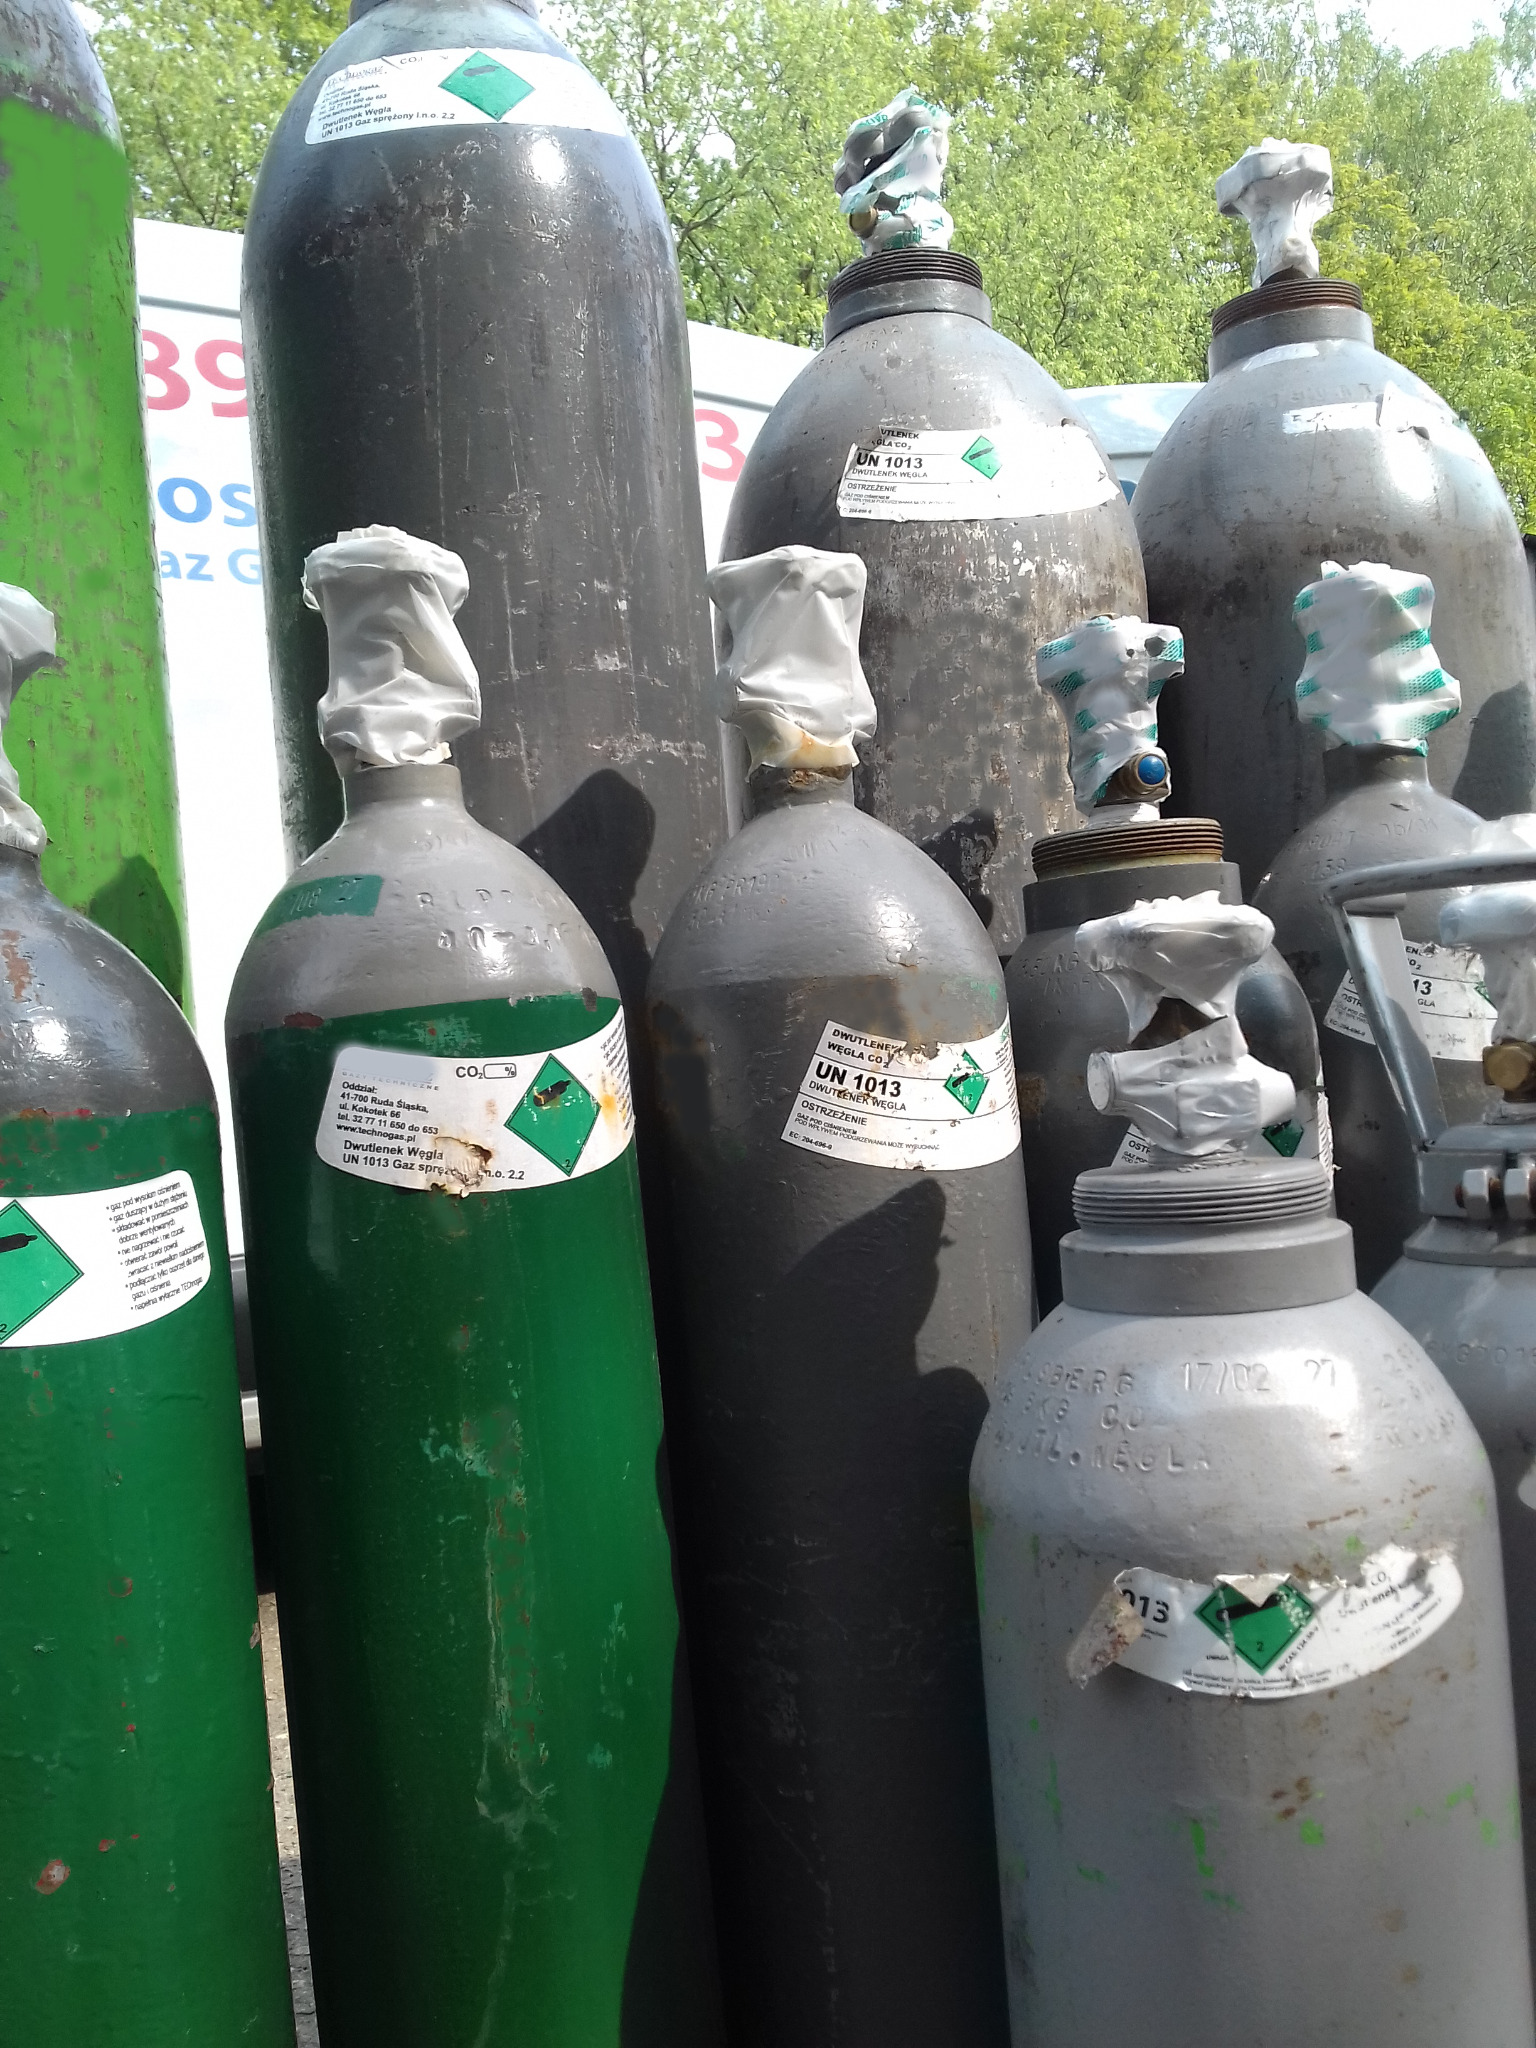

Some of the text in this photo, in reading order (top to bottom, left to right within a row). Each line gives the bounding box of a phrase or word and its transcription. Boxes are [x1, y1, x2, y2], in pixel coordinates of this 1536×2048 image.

[322, 106, 392, 130] Dwutlenek Węgla
[322, 128, 332, 138] UN
[335, 122, 353, 132] 1013
[355, 118, 372, 126] Gaz
[374, 112, 414, 123] sprężony
[442, 112, 456, 120] 2.2
[695, 409, 746, 482] 3
[856, 452, 923, 468] UN 1013
[852, 468, 898, 478] DWUTLENEK
[847, 482, 897, 492] OSTRZEŻENIE
[828, 1041, 864, 1060] WĘGLA
[342, 1081, 378, 1094] Oddział:
[816, 1060, 901, 1098] UN 1013
[340, 1092, 430, 1114] 41-700 Ruda Śląska,
[808, 1080, 906, 1111] DWUTLENEK WĘGLA
[339, 1102, 401, 1118] ul. Kokotek 66
[801, 1100, 868, 1126] OSTRZEŻENIE
[338, 1112, 439, 1134] tel. 32 77 11 650 do 653
[794, 1118, 808, 1126] POD
[808, 1122, 838, 1136] WPŁYWEM
[840, 1132, 888, 1147] PODGRZEWANIA
[796, 1112, 858, 1135] GAZ POD CIŚNIENIEM
[336, 1124, 416, 1143] www.technogas.pl
[789, 1130, 800, 1140] EC:
[344, 1140, 444, 1160] Dwutlenek Węgla
[342, 1153, 360, 1164] UN
[363, 1156, 390, 1168] 1013
[392, 1159, 416, 1170] Gaz
[508, 1170, 525, 1180] 2.2
[110, 1202, 122, 1212] gaz
[122, 1196, 134, 1209] pod
[114, 1213, 124, 1224] gaz
[119, 1232, 138, 1244] dobrze
[1256, 1642, 1264, 1651] 2
